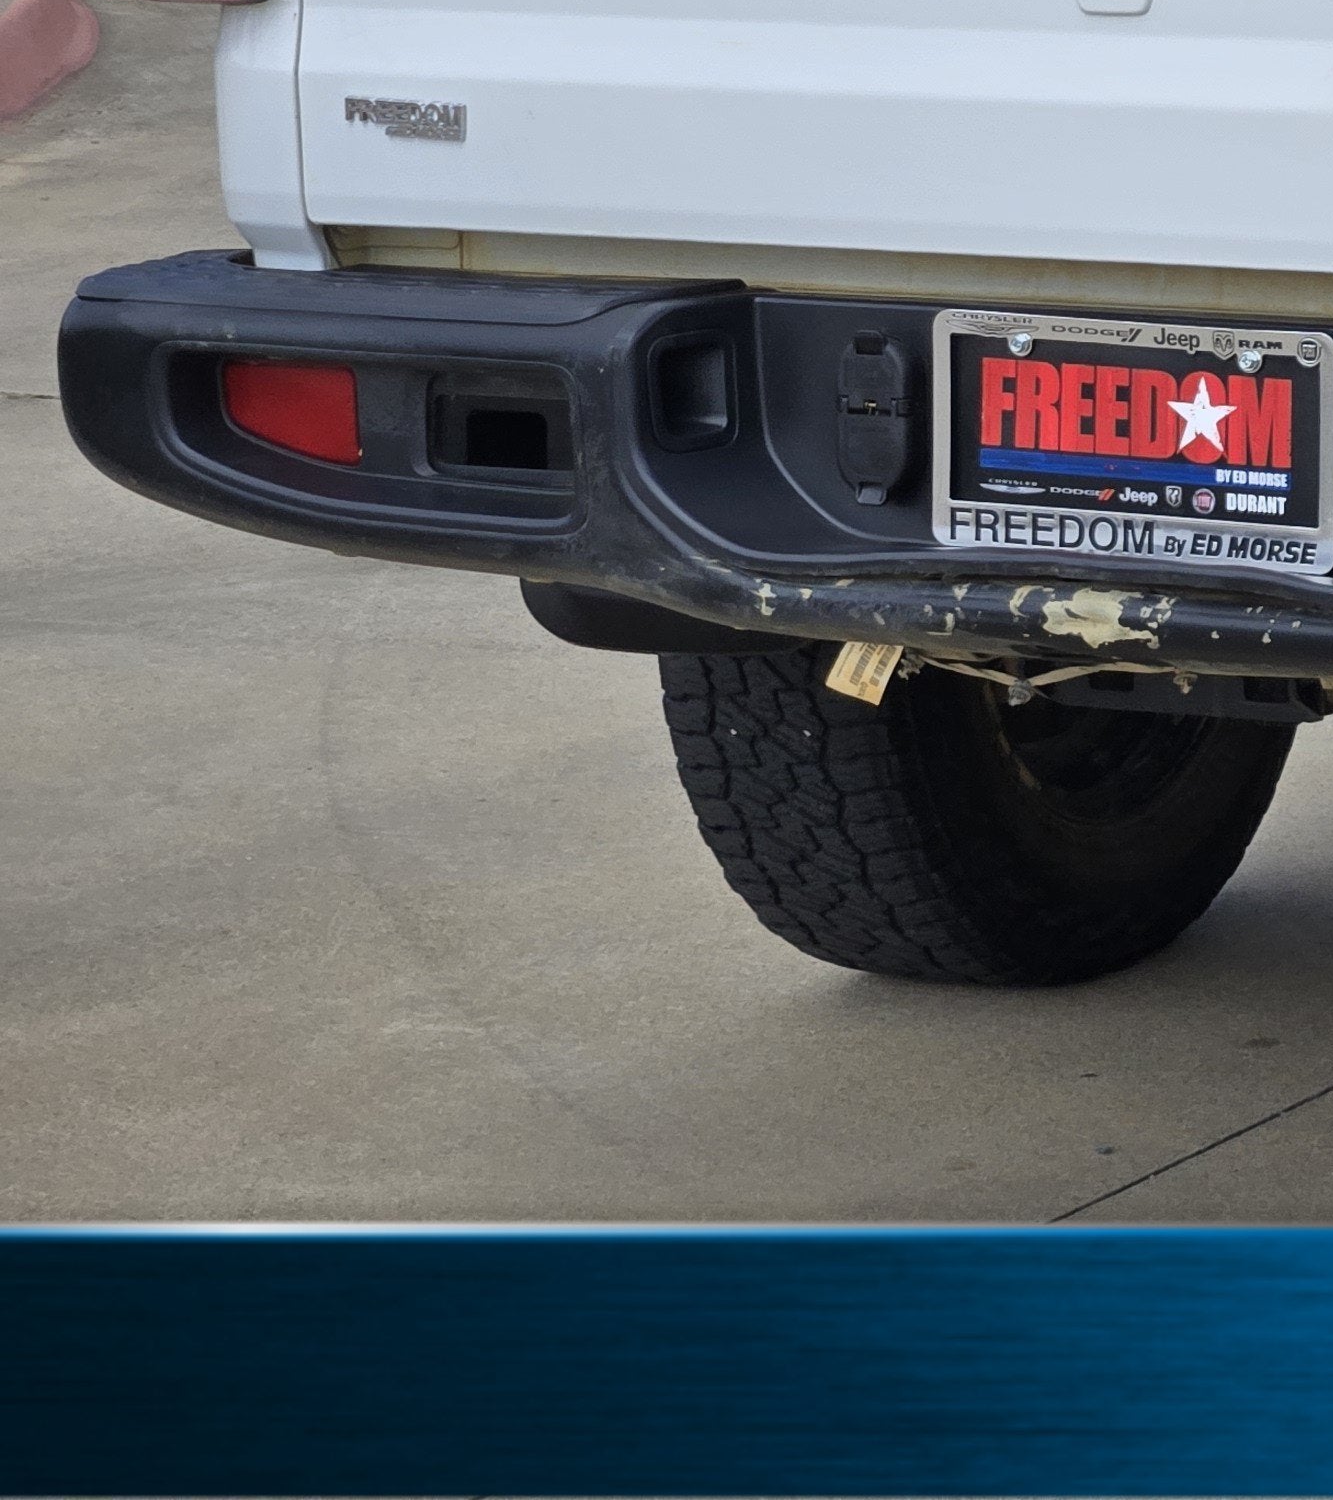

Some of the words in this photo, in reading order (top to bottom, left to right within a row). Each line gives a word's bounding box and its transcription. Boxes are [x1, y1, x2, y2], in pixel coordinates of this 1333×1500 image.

[951, 312, 1034, 325] CHRYSLER
[1051, 325, 1130, 338] DODGE
[1153, 328, 1201, 352] Jeep
[1238, 339, 1283, 350] RAM
[980, 357, 1293, 469] FREEDOM
[1215, 468, 1232, 484] BY
[1232, 470, 1247, 485] ED
[1248, 472, 1289, 488] MORSE
[1049, 486, 1101, 497] DODGE
[1118, 487, 1159, 507] Jeep
[1226, 492, 1288, 516] DURANT
[949, 507, 1156, 555] FREEDOM
[1163, 535, 1188, 557] By
[1189, 533, 1224, 557] ED
[1226, 536, 1318, 565] MORSE
